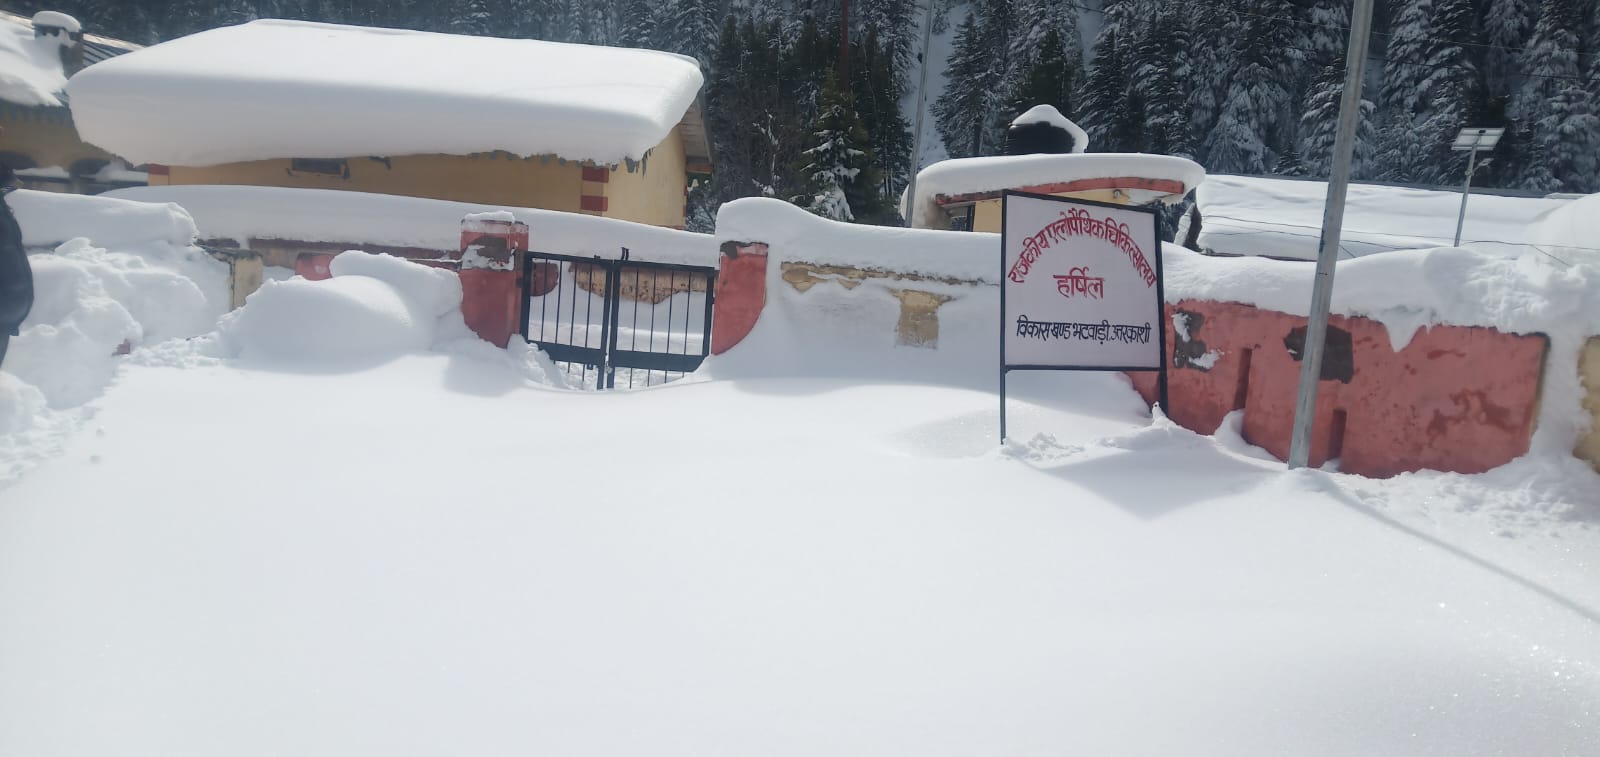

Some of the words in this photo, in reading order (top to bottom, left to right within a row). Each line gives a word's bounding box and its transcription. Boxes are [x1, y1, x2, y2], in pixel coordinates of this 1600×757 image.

[1007, 236, 1050, 283] राजकीय
[1053, 266, 1104, 300] हर्षिल
[1016, 314, 1051, 341] विकास
